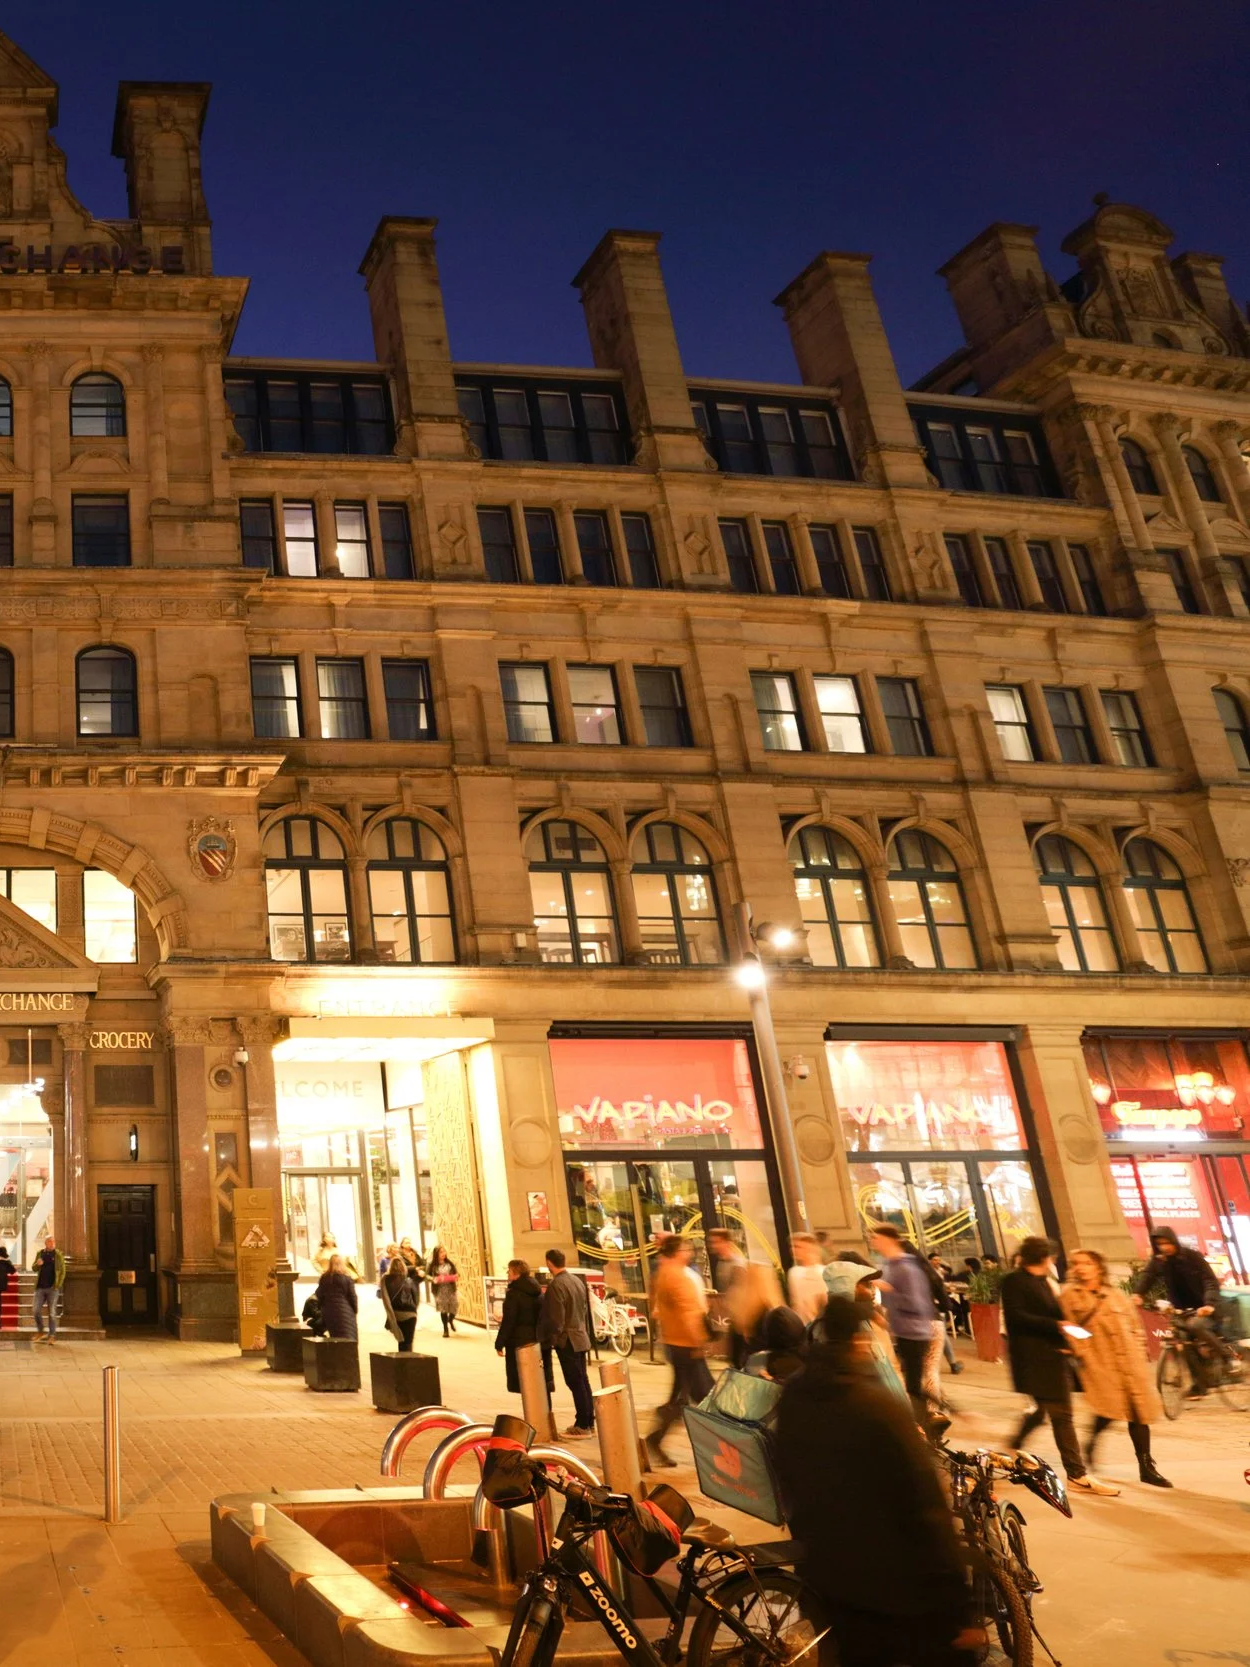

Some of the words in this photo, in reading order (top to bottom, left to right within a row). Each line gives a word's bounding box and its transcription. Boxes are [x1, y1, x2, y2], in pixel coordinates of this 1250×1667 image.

[89, 1031, 155, 1049] GROCERY
[280, 1080, 364, 1098] LCOME
[589, 1586, 637, 1649] zoomo
